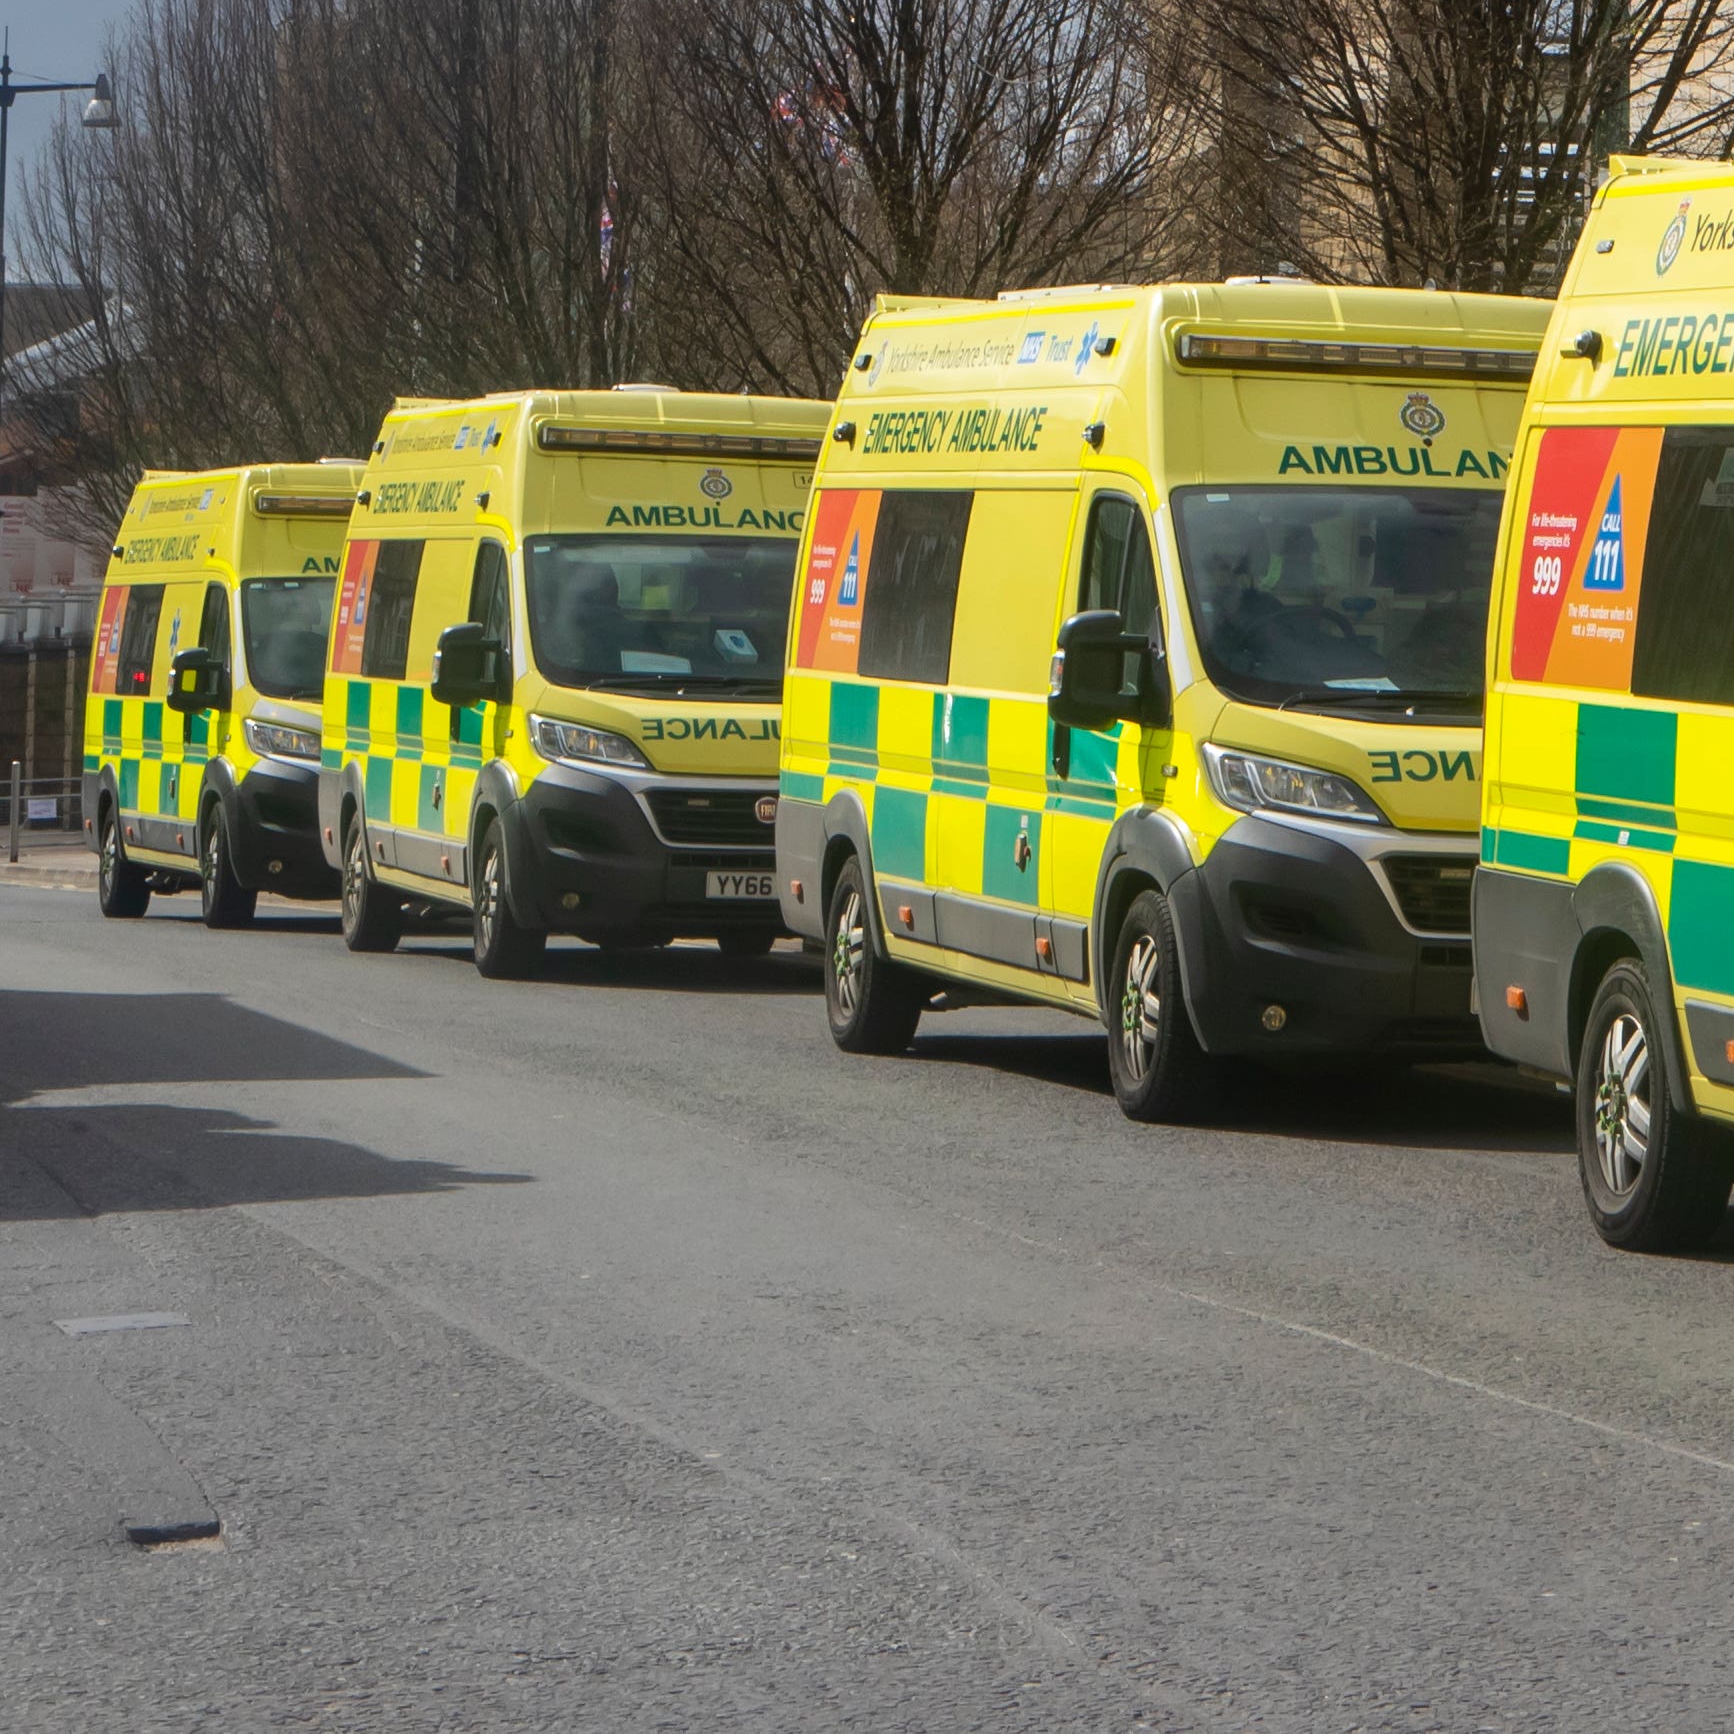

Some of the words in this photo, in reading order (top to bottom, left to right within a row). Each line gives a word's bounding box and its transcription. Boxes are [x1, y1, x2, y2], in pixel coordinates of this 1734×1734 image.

[927, 339, 978, 369] Ambulance
[978, 336, 1015, 367] Service
[1018, 333, 1045, 362] NHS
[1046, 334, 1073, 362] Trust
[863, 410, 953, 454] EMERGENCY
[947, 407, 1048, 453] AMBULANCE
[1279, 445, 1508, 479] AMBULAN
[416, 479, 465, 513] AMBULANCE
[606, 505, 805, 532] AMBULANC
[1602, 513, 1620, 532] CALL
[1531, 555, 1562, 595] 999
[1594, 540, 1620, 581] 111
[810, 579, 825, 604] 999
[843, 571, 857, 599] 111
[717, 875, 772, 896] YY66
